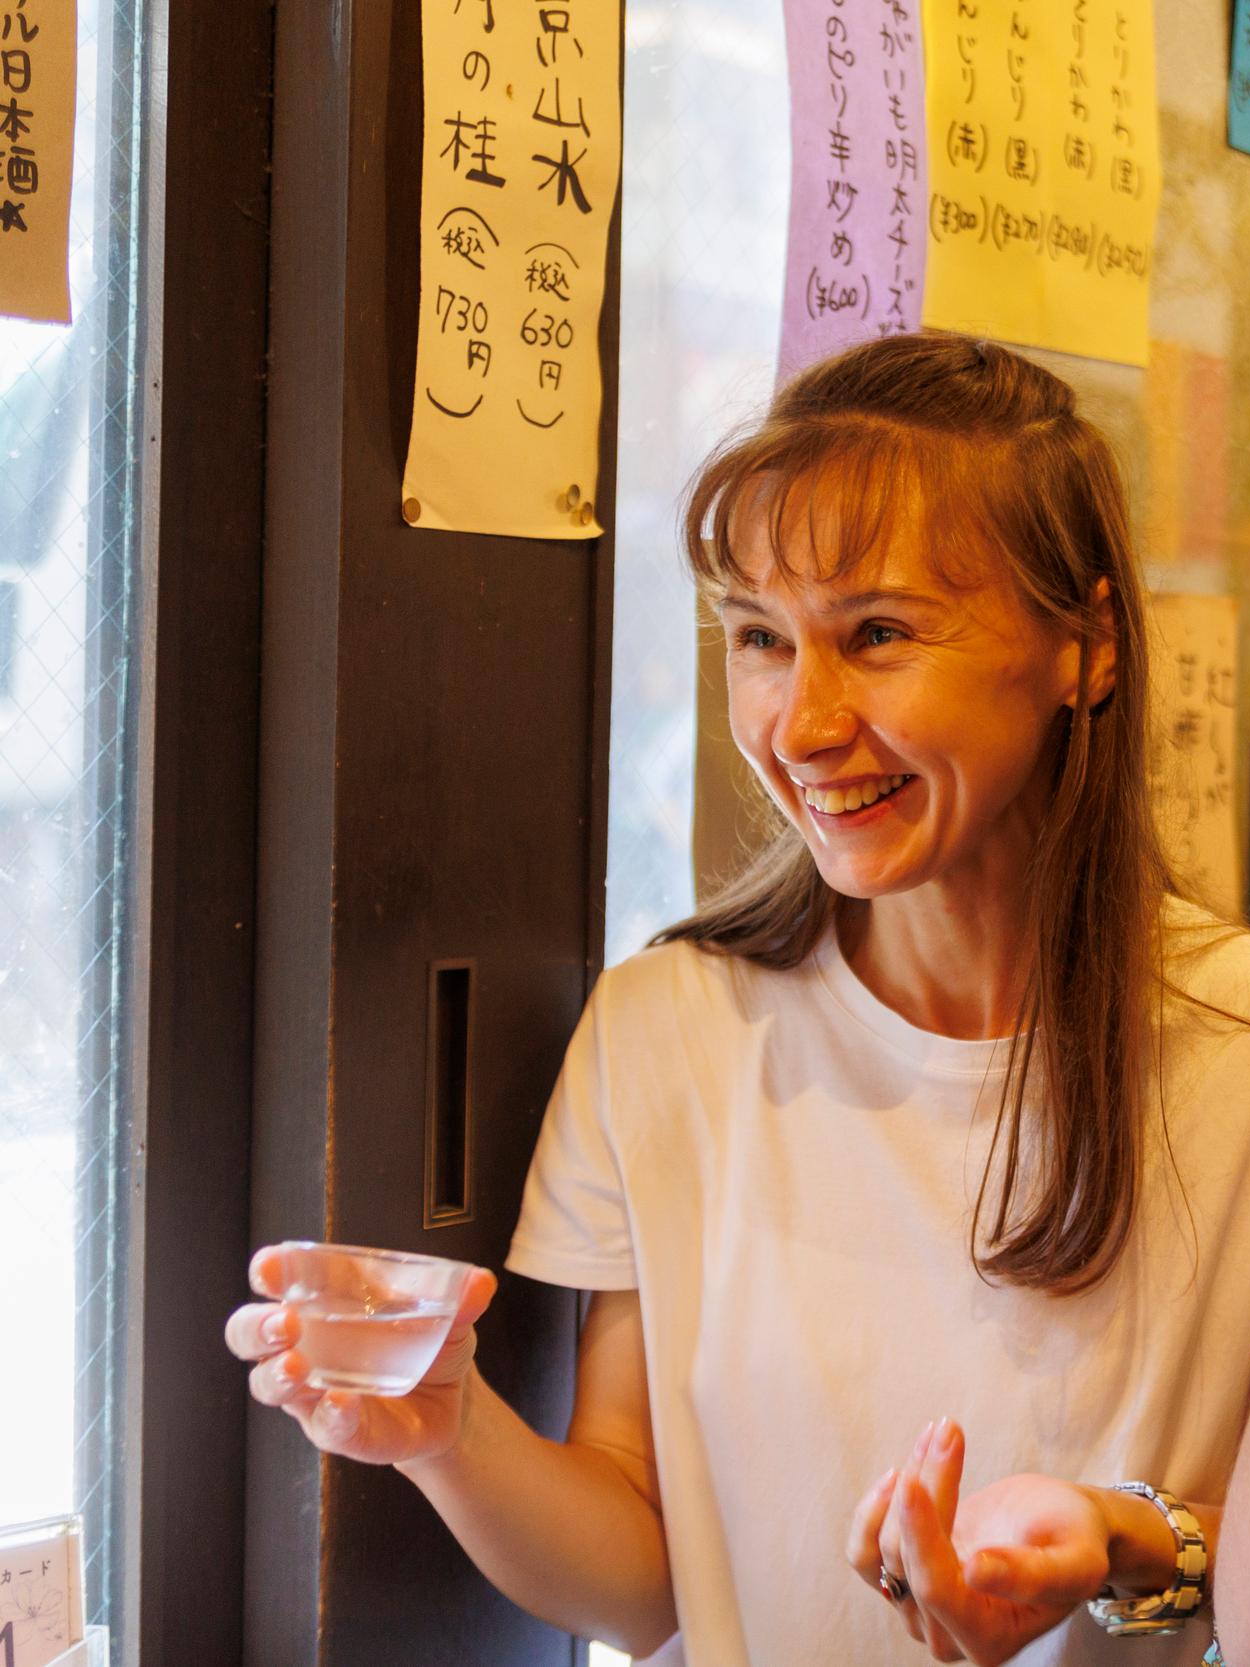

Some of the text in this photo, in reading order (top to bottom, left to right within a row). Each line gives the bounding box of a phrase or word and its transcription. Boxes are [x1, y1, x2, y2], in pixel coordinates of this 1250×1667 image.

[0, 0, 39, 194] ル日本酒
[825, 0, 858, 268] のピリ辛炒め
